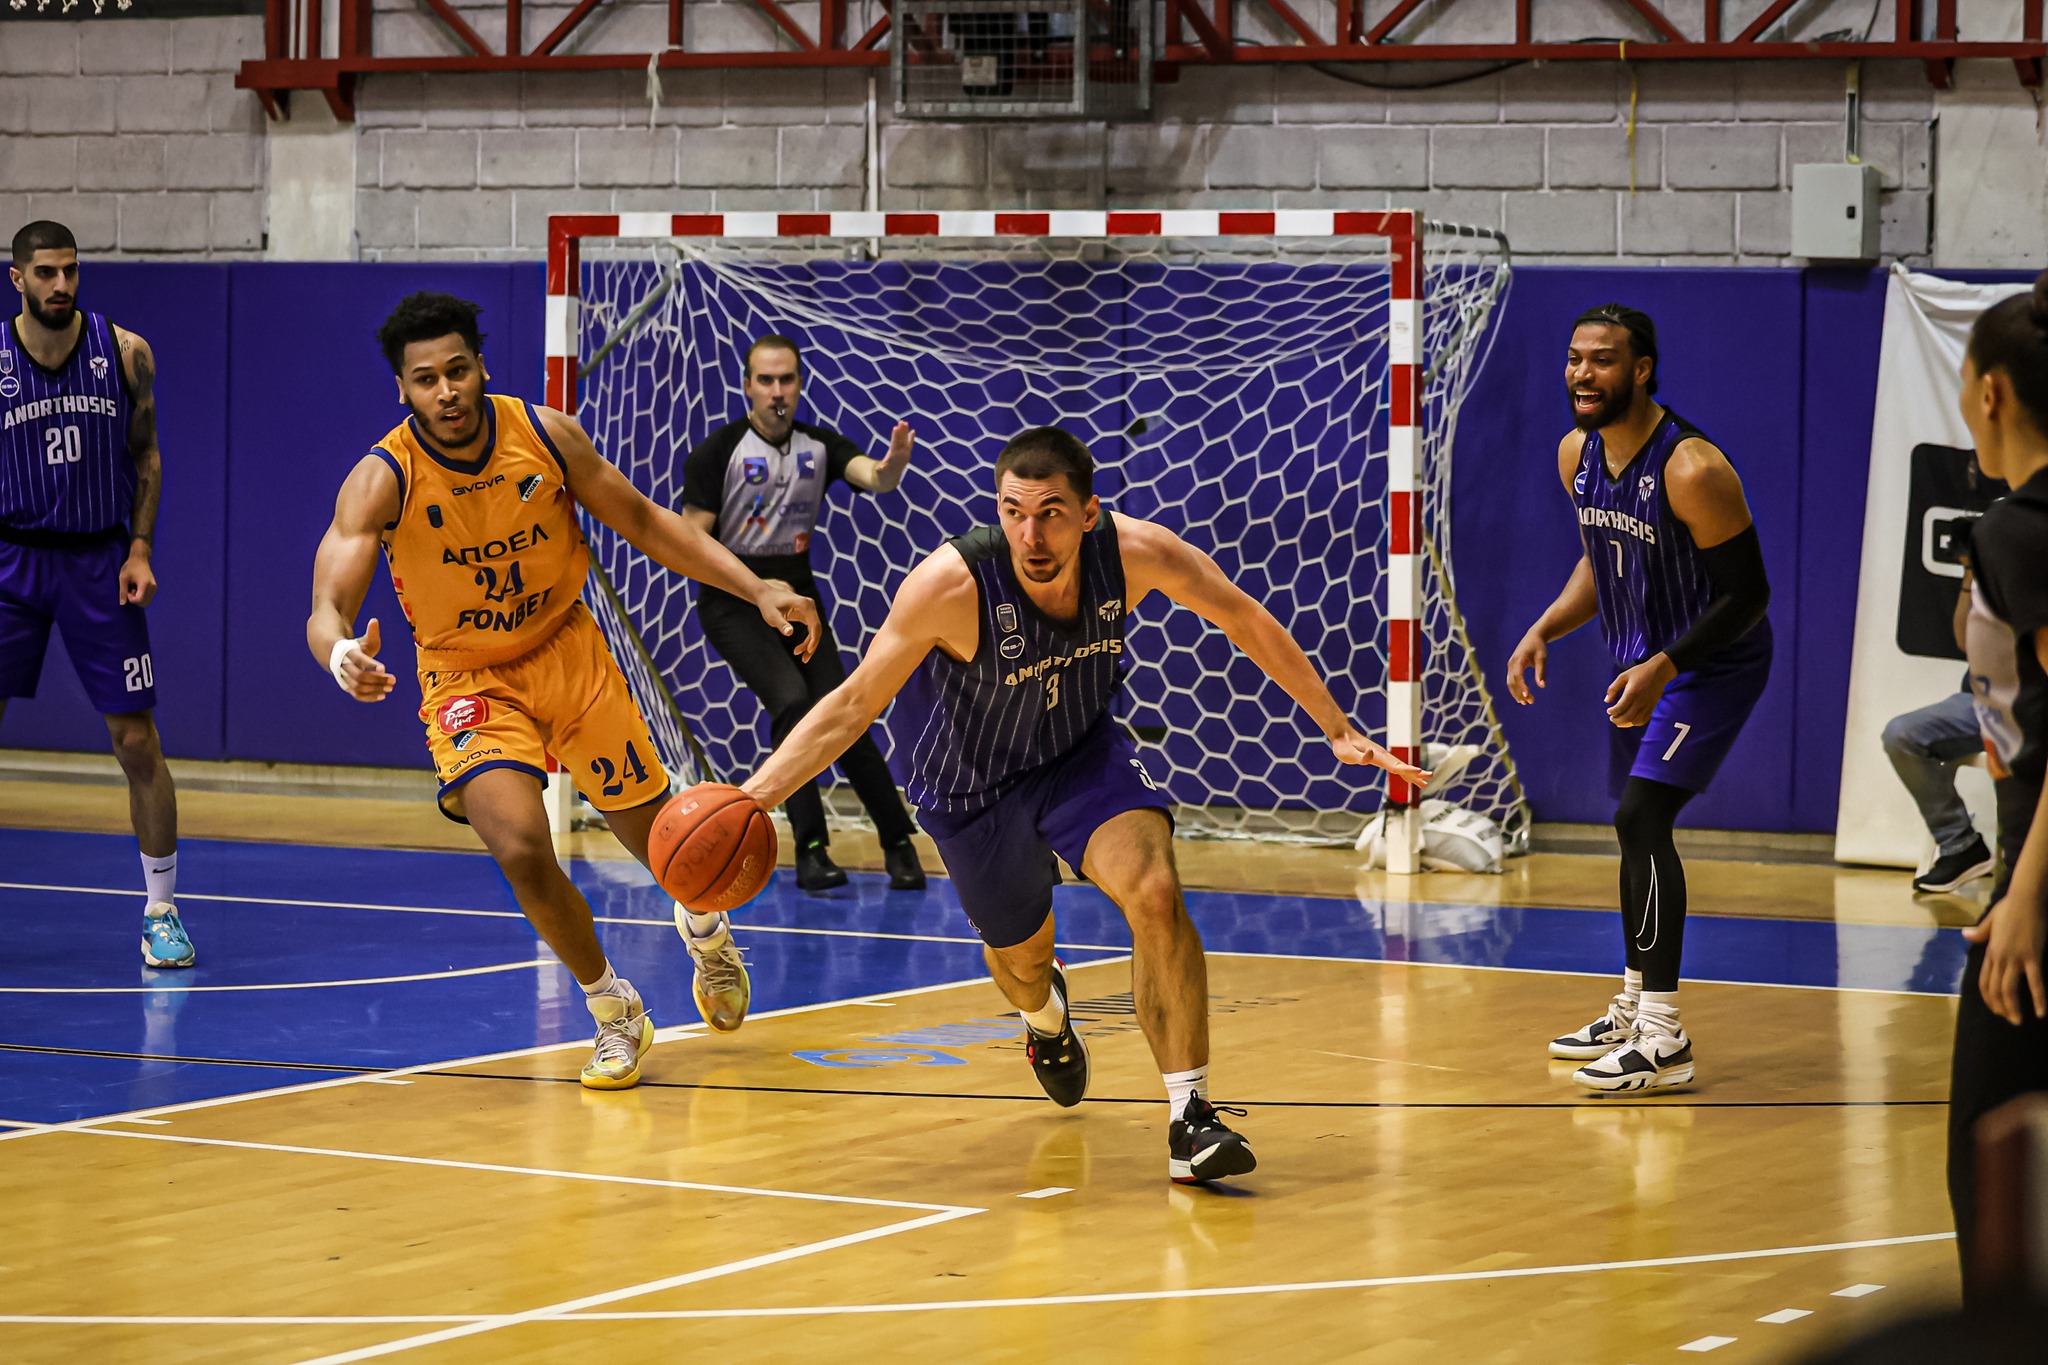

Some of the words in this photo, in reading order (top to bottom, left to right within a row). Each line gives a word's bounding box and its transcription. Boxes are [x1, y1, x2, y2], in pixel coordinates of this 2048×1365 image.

[4, 395, 117, 430] ANORTHOSIS
[46, 425, 82, 465] 20
[452, 474, 506, 497] GIVOVA
[1609, 540, 1623, 578] 7
[475, 560, 526, 602] 24
[456, 586, 555, 633] FONBET
[124, 653, 154, 693] 20
[1045, 672, 1061, 712] 3
[445, 707, 476, 726] Pizza
[452, 714, 476, 730] Hut
[450, 748, 502, 773] GIVOVA
[1661, 722, 1691, 761] 7
[590, 739, 650, 797] 24
